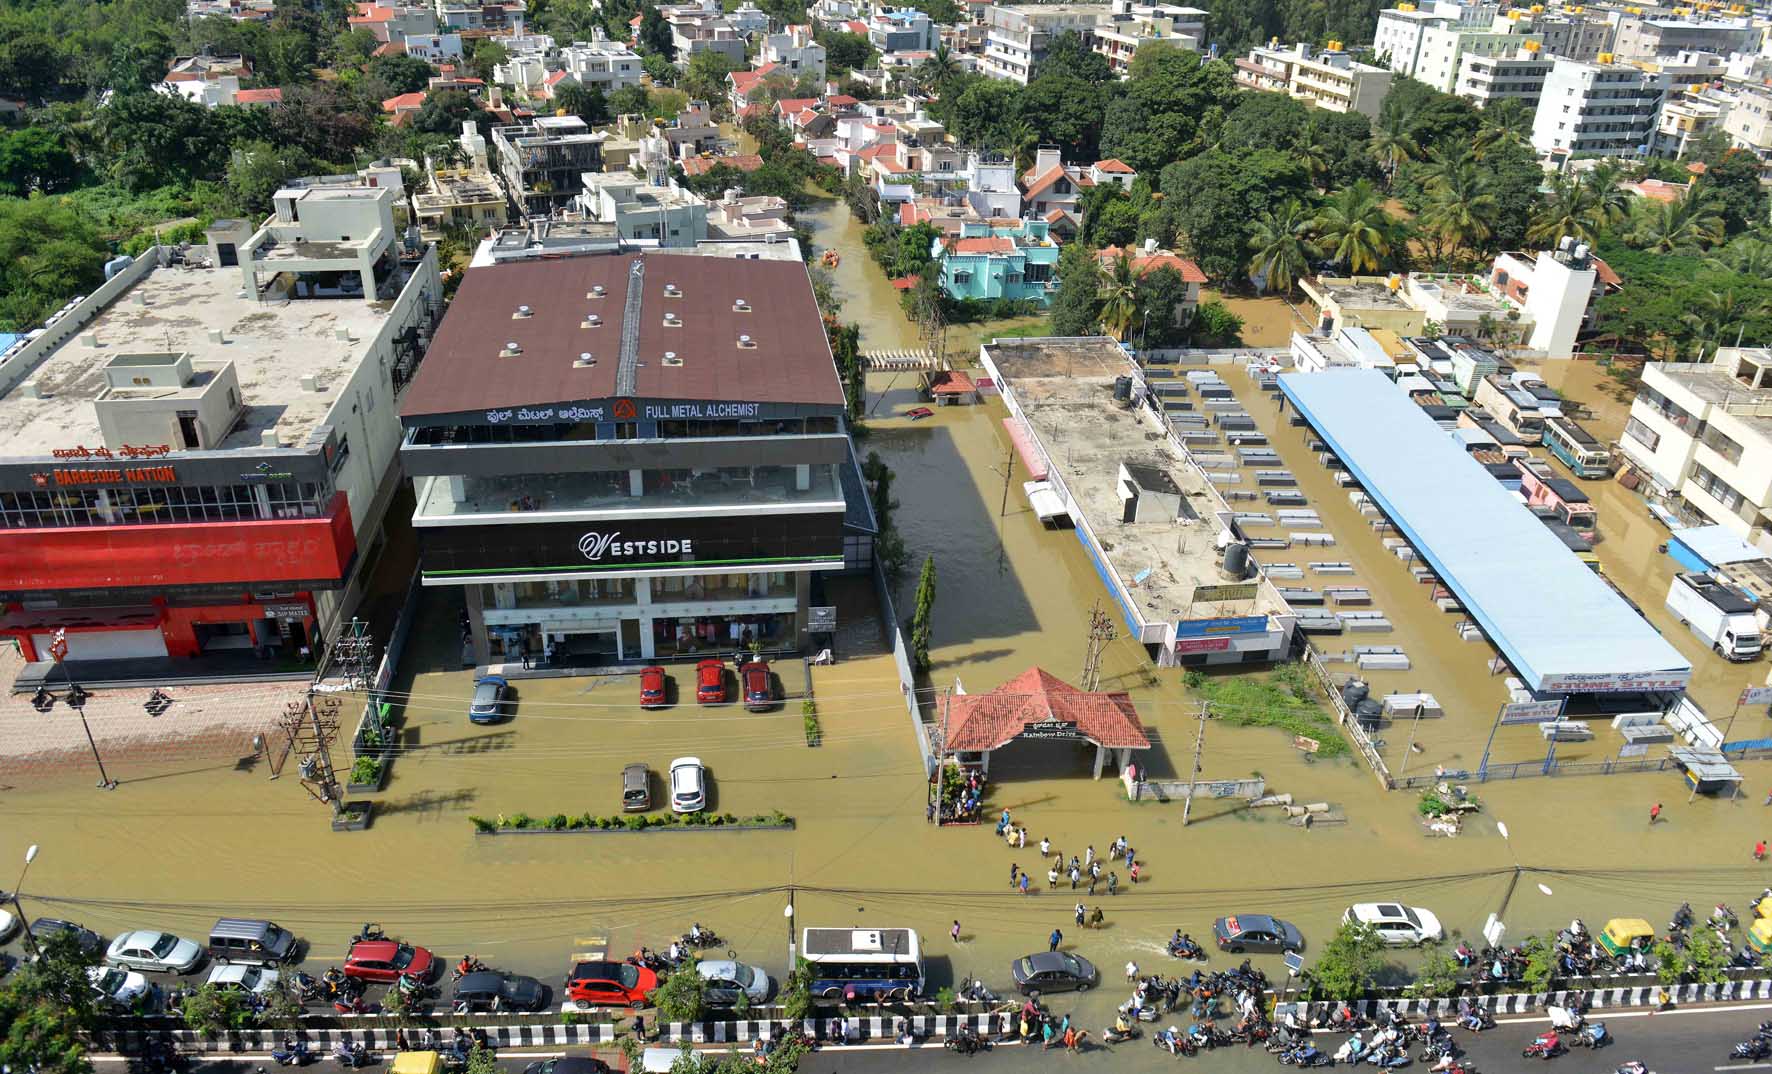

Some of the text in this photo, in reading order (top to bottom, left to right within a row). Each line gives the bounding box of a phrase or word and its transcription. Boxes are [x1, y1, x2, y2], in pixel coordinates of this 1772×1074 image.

[518, 408, 553, 420] ಮೆಟಲ್
[646, 403, 759, 418] FULL METAL ALCHEMIST
[53, 465, 177, 486] BARBEQUE NATION
[1550, 679, 1683, 690] STONE STYLE
